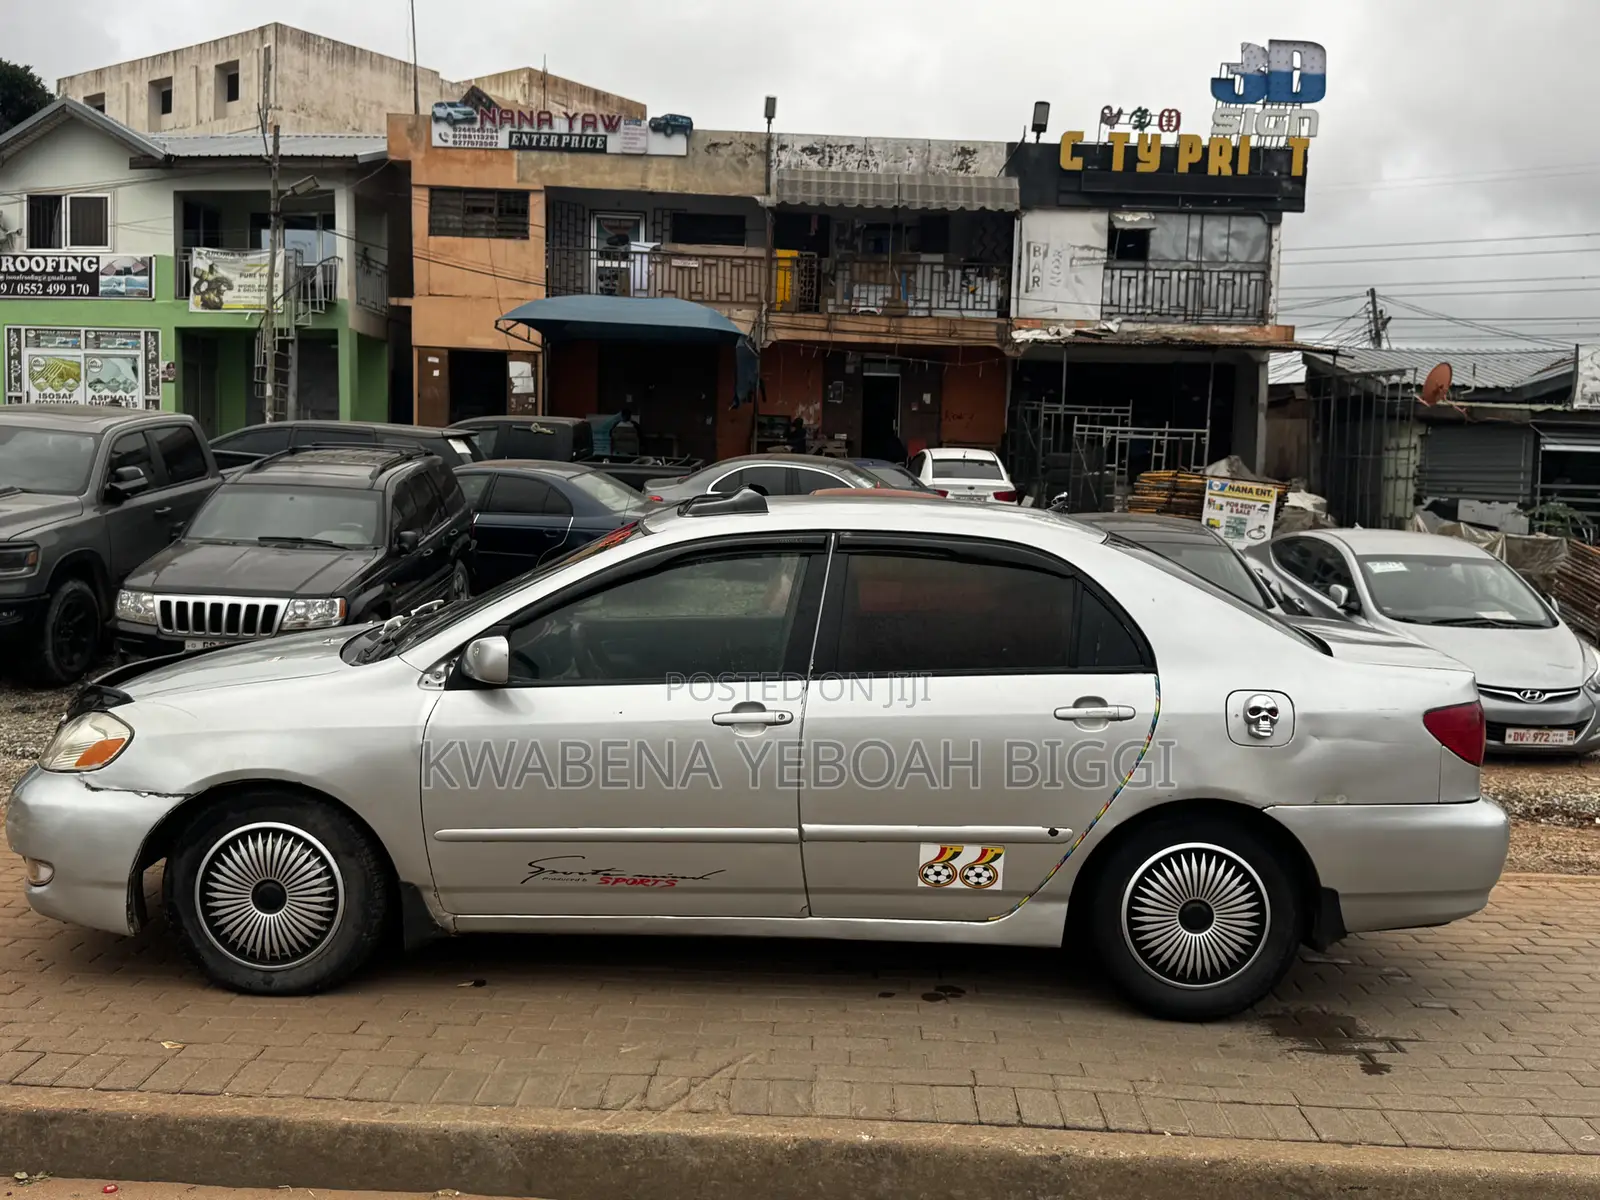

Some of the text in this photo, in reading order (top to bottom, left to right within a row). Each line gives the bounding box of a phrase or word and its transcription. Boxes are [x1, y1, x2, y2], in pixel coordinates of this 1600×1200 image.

[479, 107, 622, 133] NANA YAW
[0, 256, 98, 273] ROOFING
[17, 282, 43, 295] 0552
[46, 283, 67, 295] 499
[70, 283, 90, 296] 170
[1228, 484, 1254, 495] NANA
[1255, 488, 1273, 498] ENT.
[1533, 731, 1550, 743] 972
[597, 876, 678, 888] SPORTS
